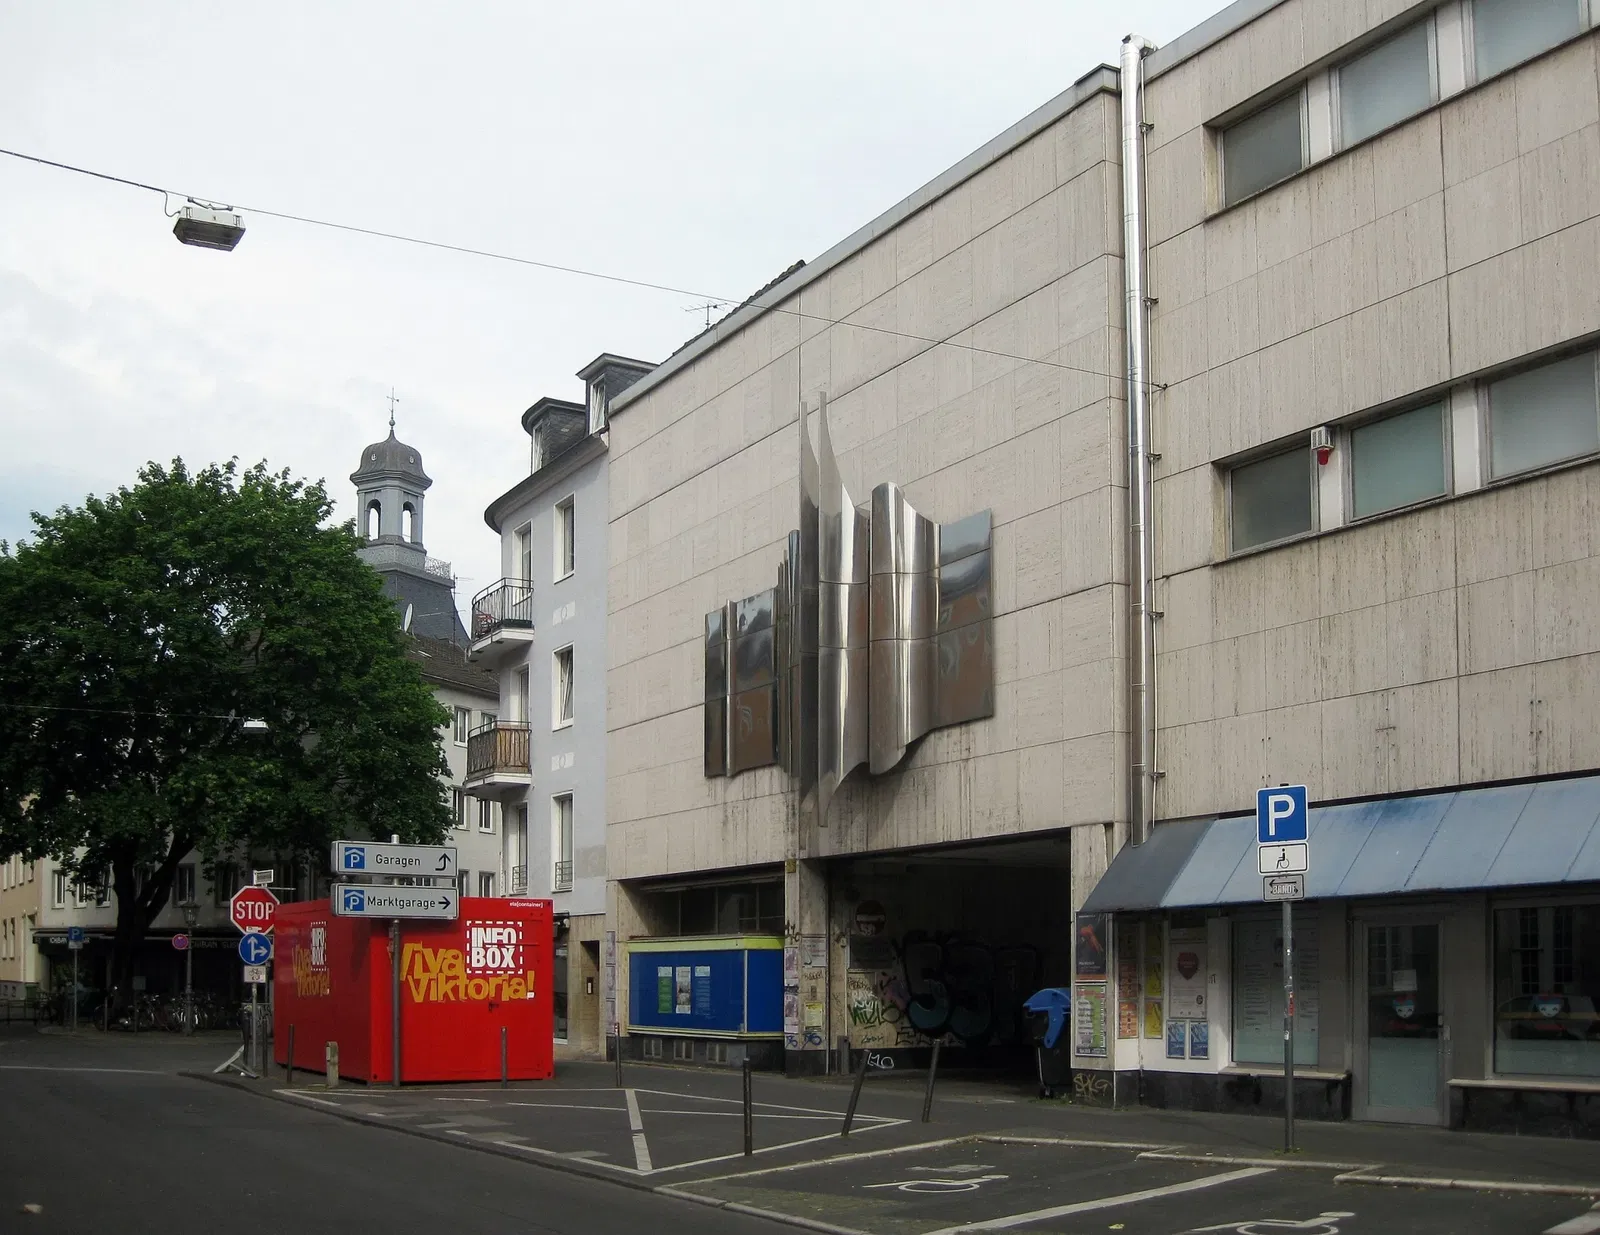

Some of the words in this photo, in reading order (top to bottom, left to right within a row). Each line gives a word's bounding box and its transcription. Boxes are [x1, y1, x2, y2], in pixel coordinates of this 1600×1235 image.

[1268, 794, 1295, 836] P
[375, 854, 421, 867] Garagen
[235, 900, 274, 920] STOP
[367, 896, 436, 910] Marktgarage
[471, 927, 517, 948] INFO
[471, 945, 516, 968] BOX
[407, 970, 535, 1003] Viktoria!
